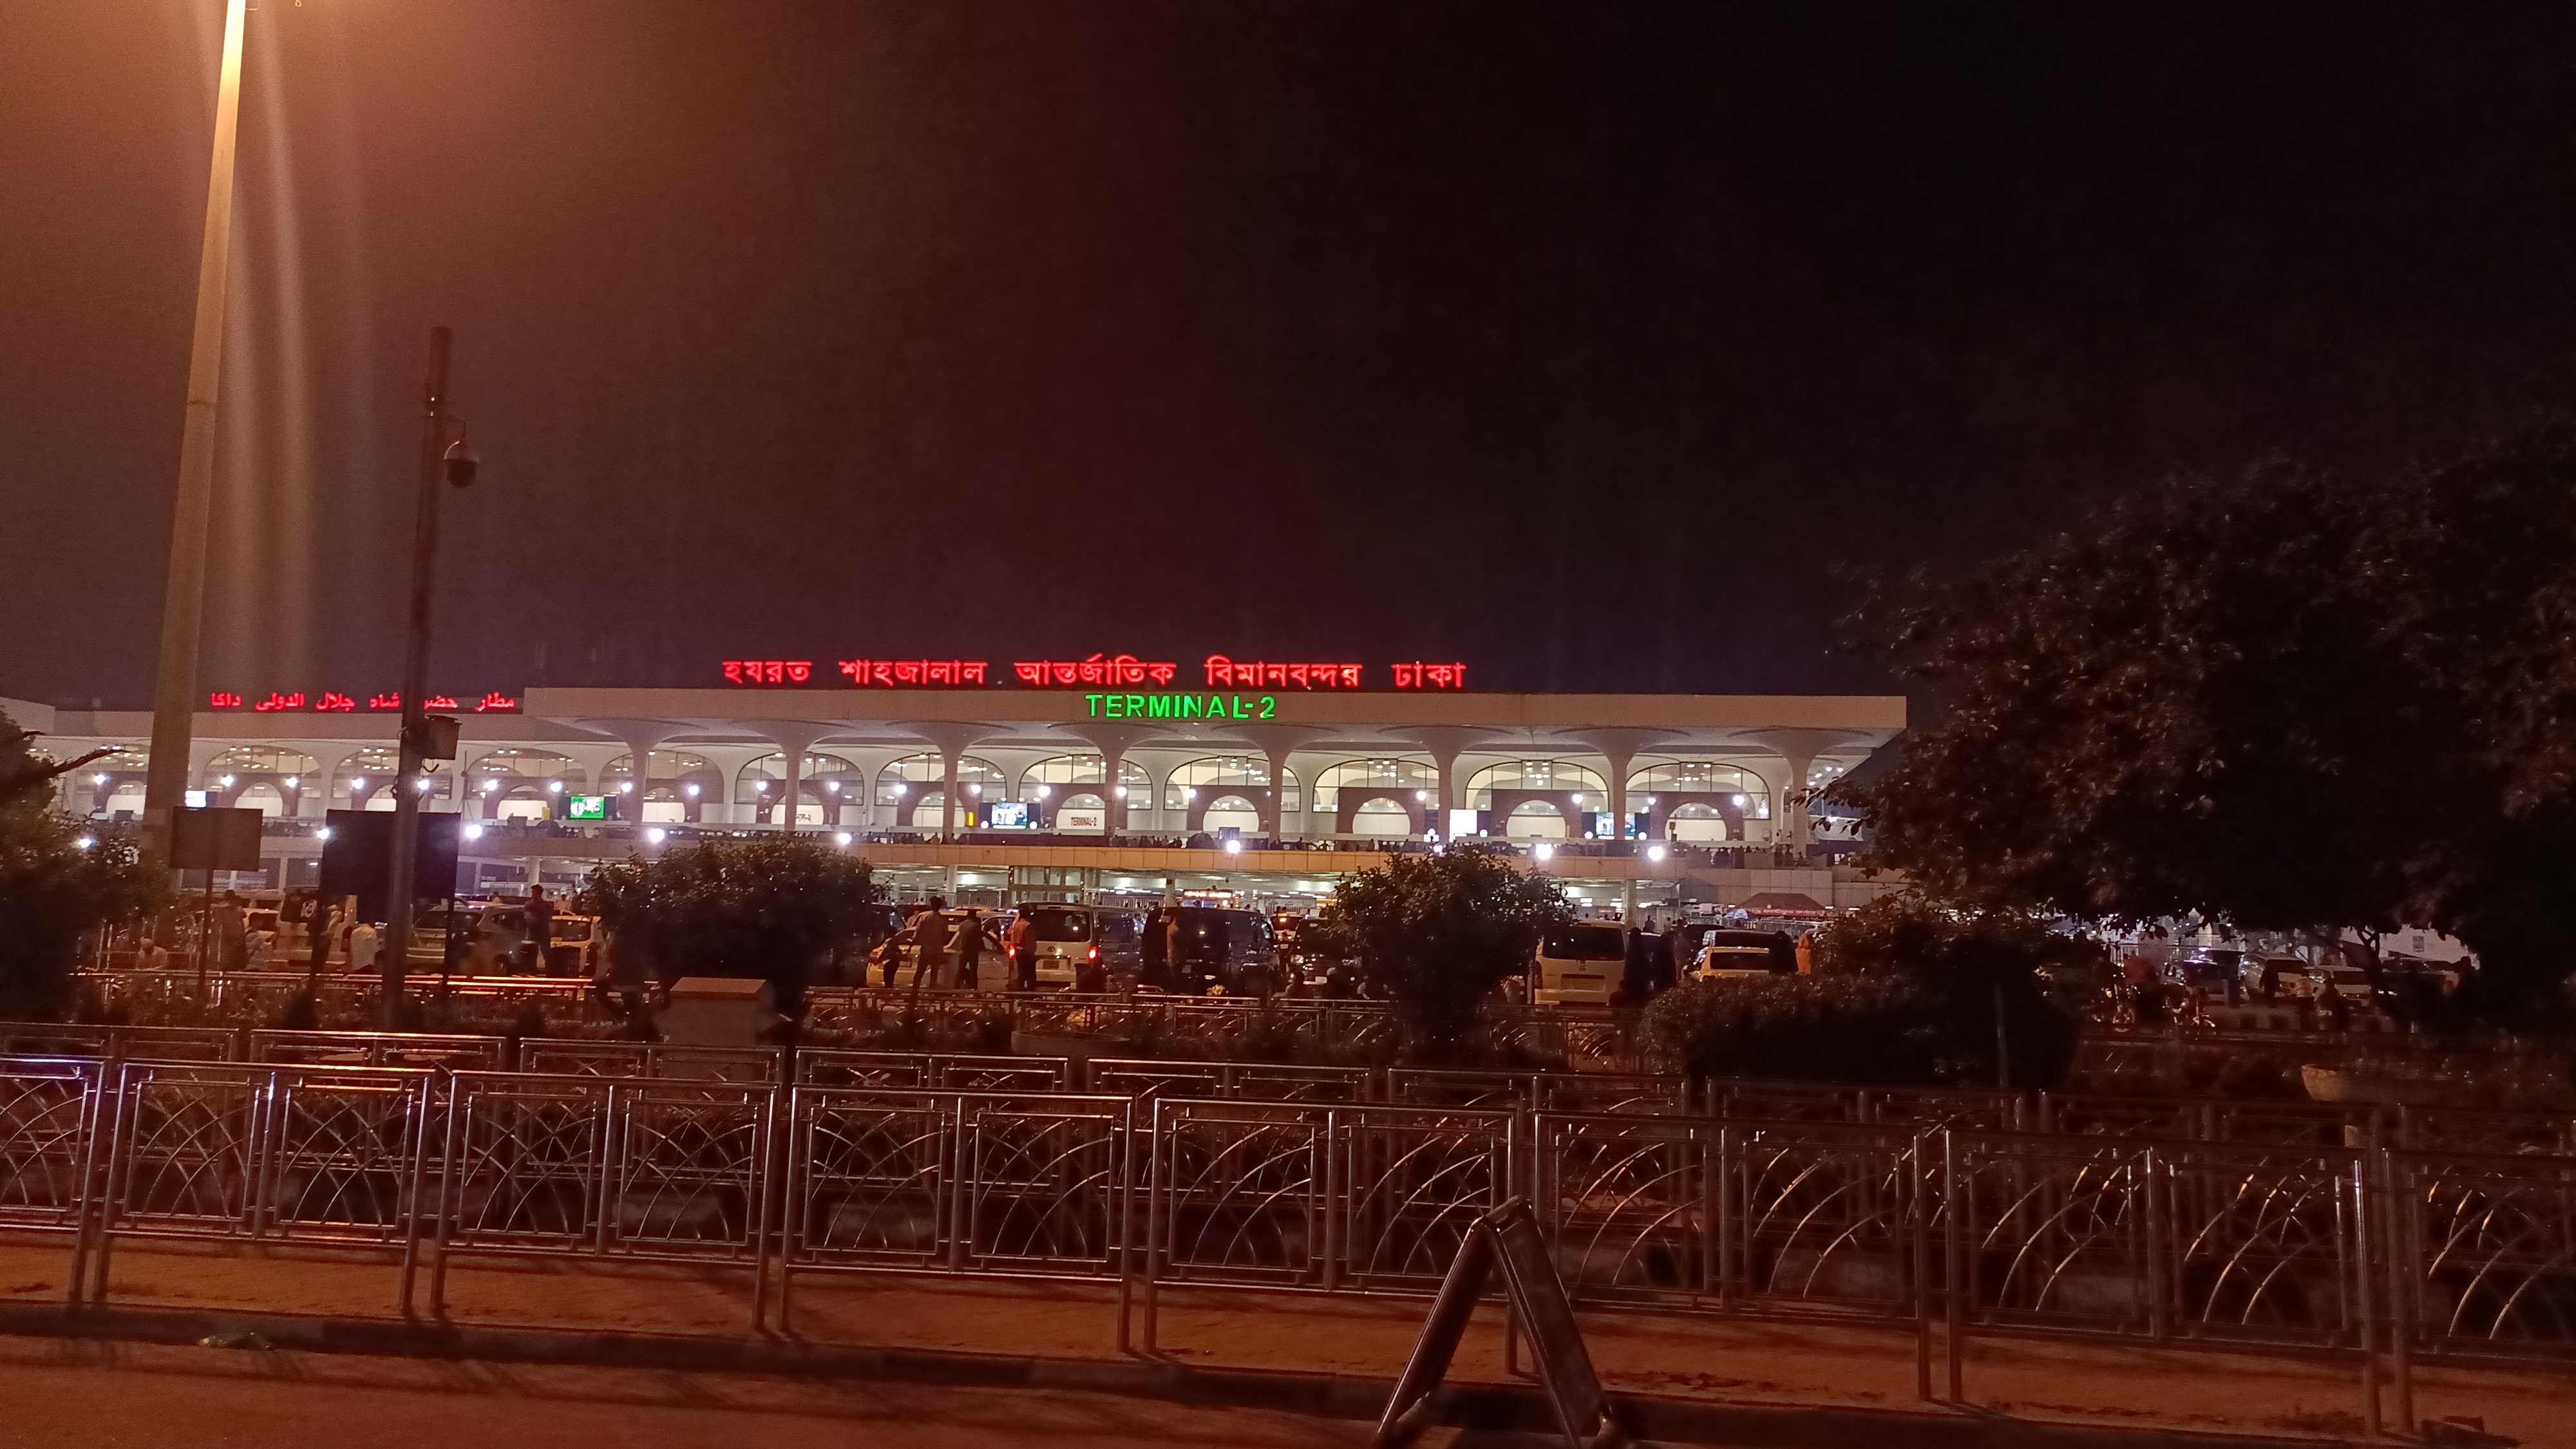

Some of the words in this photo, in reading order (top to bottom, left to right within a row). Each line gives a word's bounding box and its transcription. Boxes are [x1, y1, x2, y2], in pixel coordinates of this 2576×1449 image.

[722, 660, 813, 685] হযরত
[838, 659, 989, 687] শাহজালাল
[1014, 653, 1178, 687] আন্তর্জাতিক
[1203, 654, 1363, 688] বিমানবন্দর
[1392, 661, 1467, 689] ঢাকা
[211, 692, 243, 710] داكا
[315, 692, 357, 714] جلال
[369, 692, 401, 711] شاه
[423, 695, 459, 712] حضر
[475, 692, 516, 714] مطار
[1085, 694, 1276, 720] TERMINAL-2
